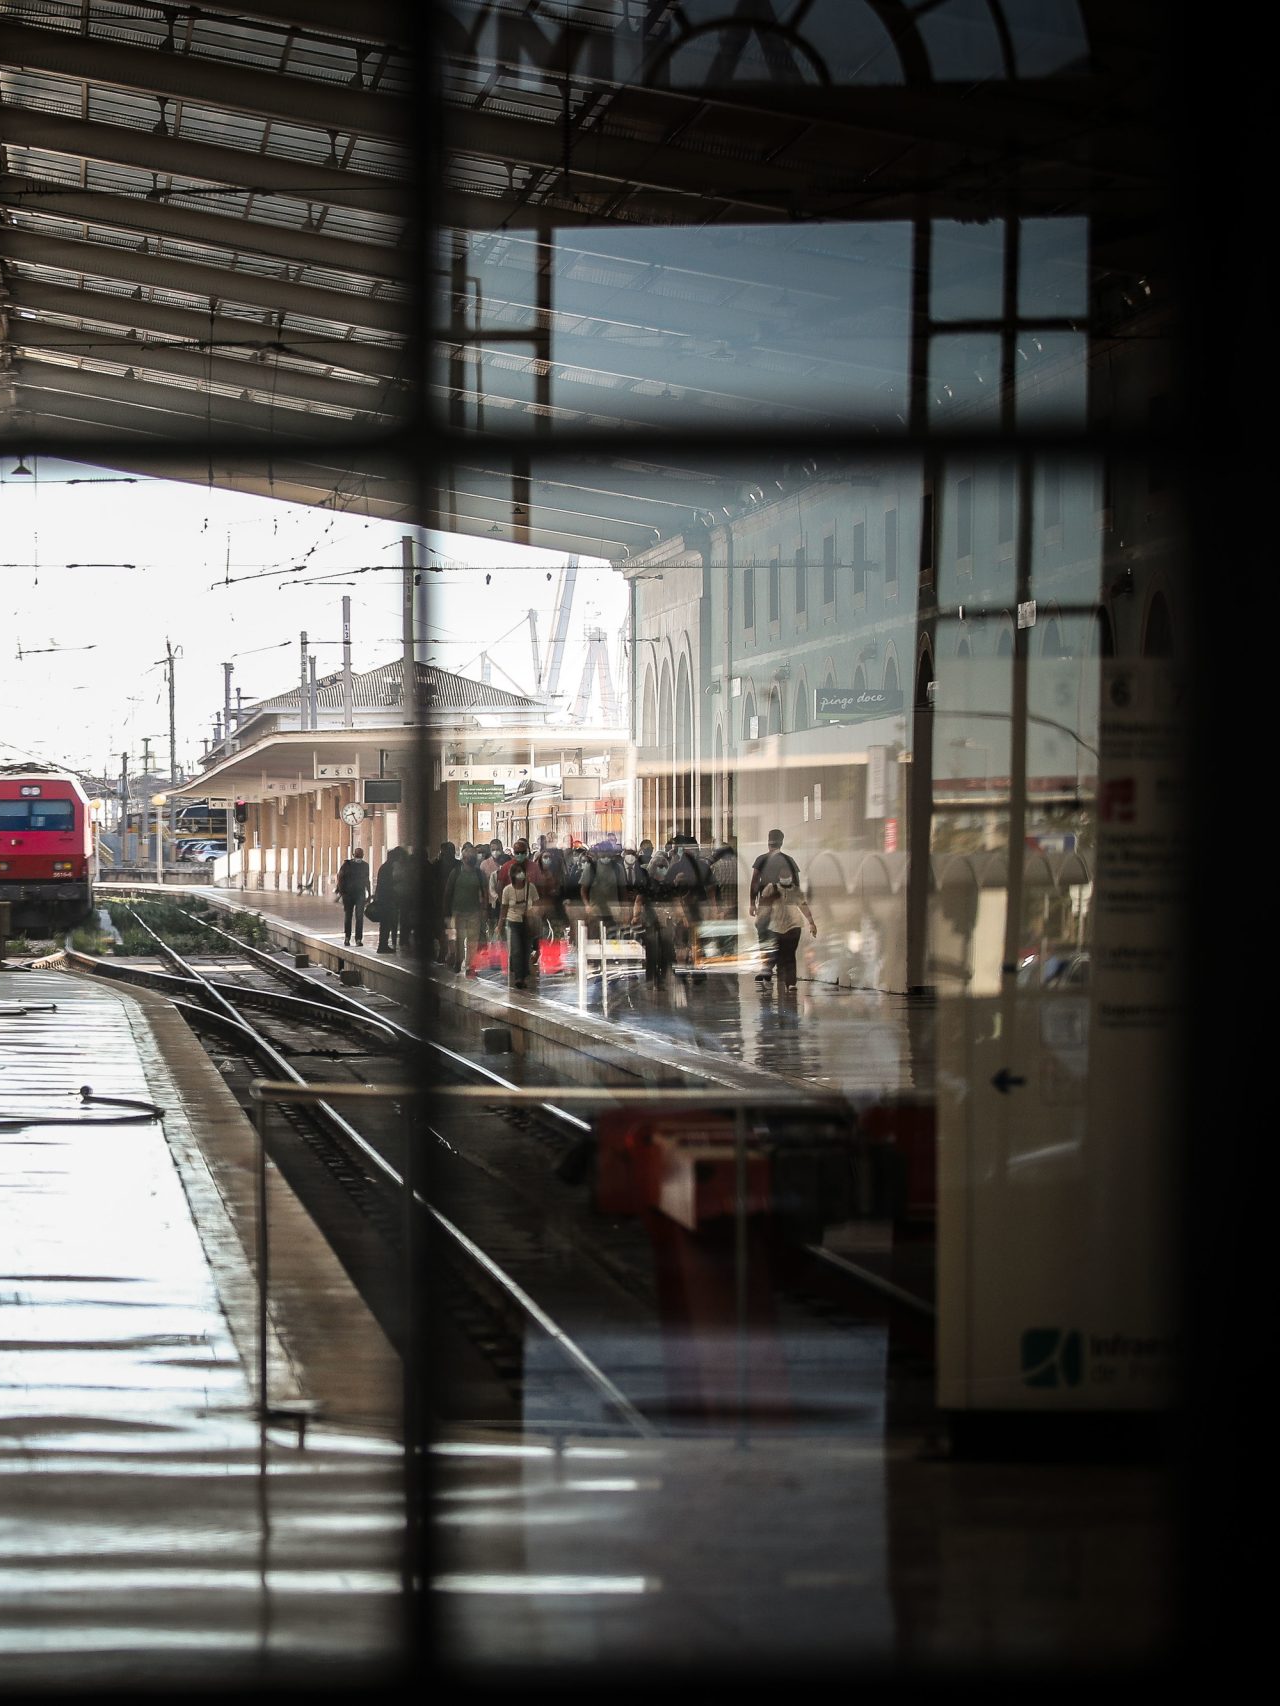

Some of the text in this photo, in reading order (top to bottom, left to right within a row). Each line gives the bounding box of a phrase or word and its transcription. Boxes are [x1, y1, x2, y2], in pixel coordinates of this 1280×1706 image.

[820, 692, 886, 712] pingo doce
[464, 770, 469, 778] 5
[492, 770, 498, 778] 6
